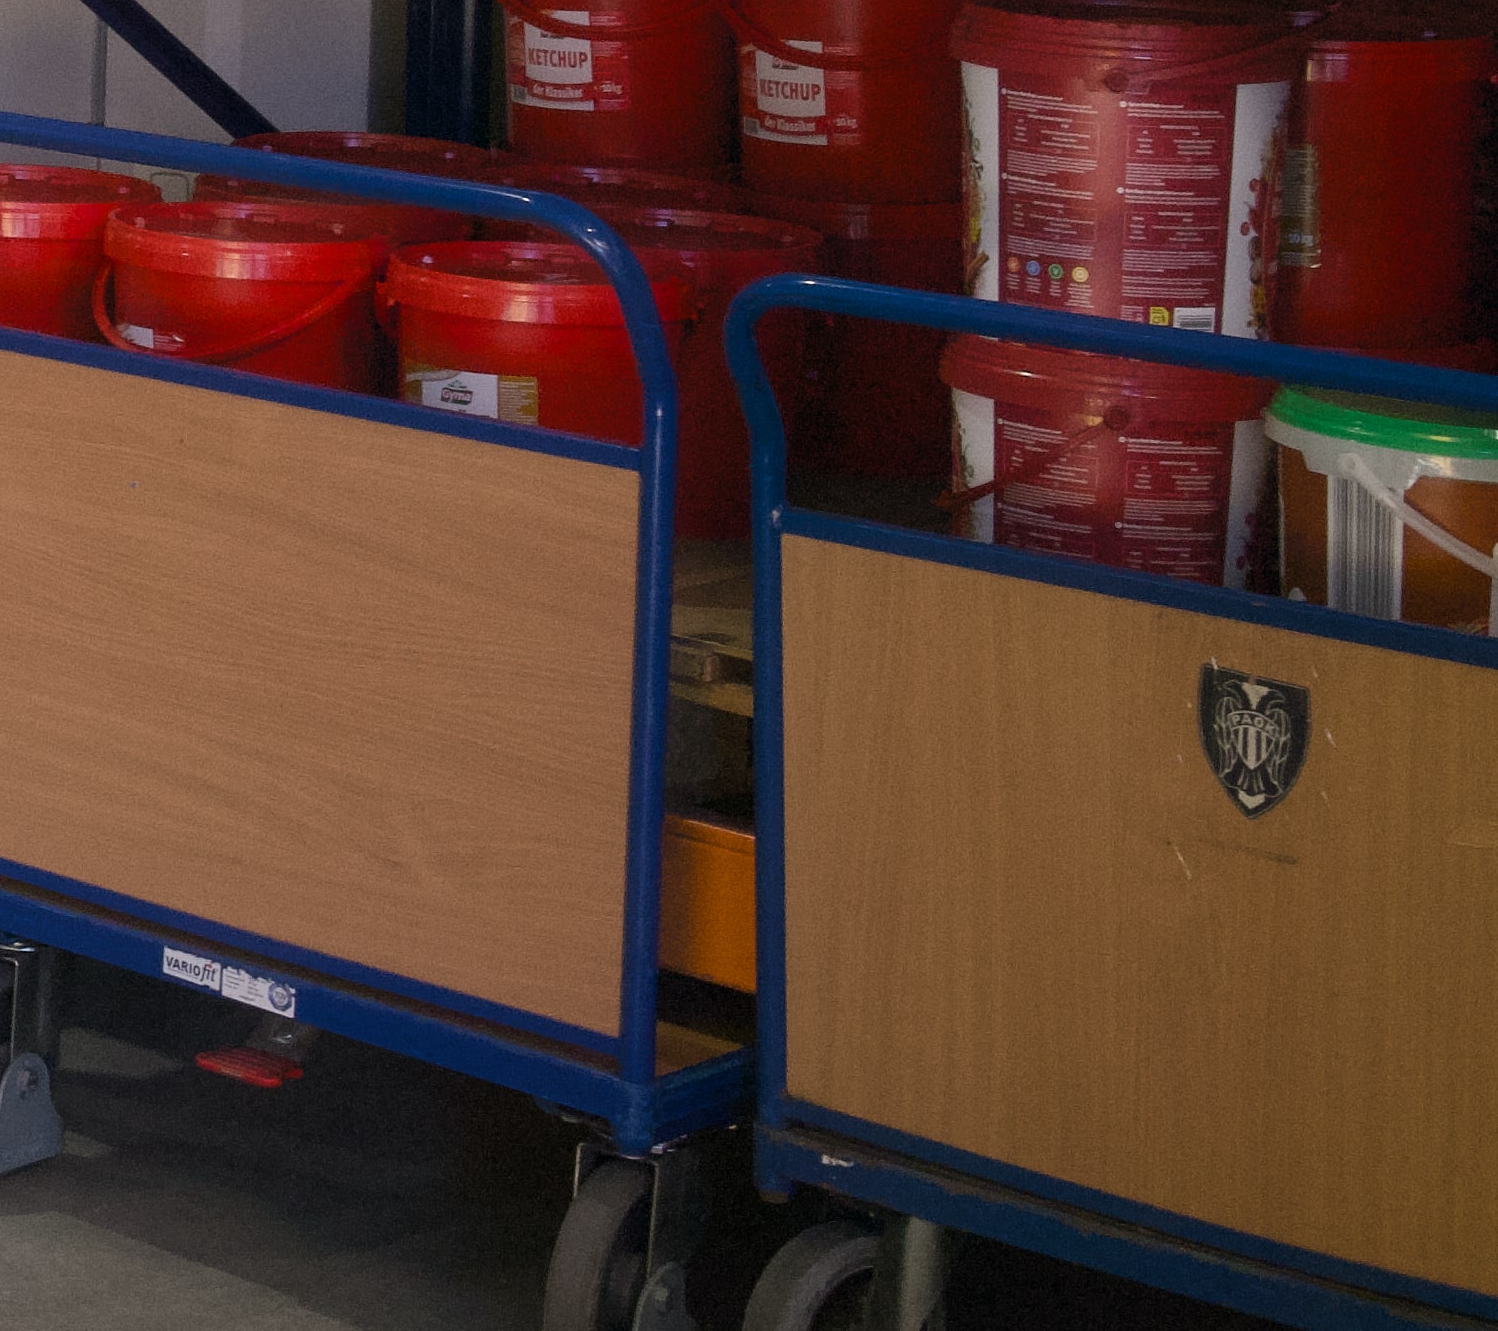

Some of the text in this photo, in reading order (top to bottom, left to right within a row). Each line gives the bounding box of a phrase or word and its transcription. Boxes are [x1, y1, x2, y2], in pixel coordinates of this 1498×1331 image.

[528, 48, 587, 69] KETCHUP
[759, 79, 821, 101] KETCHUP
[1232, 714, 1279, 736] PAOK
